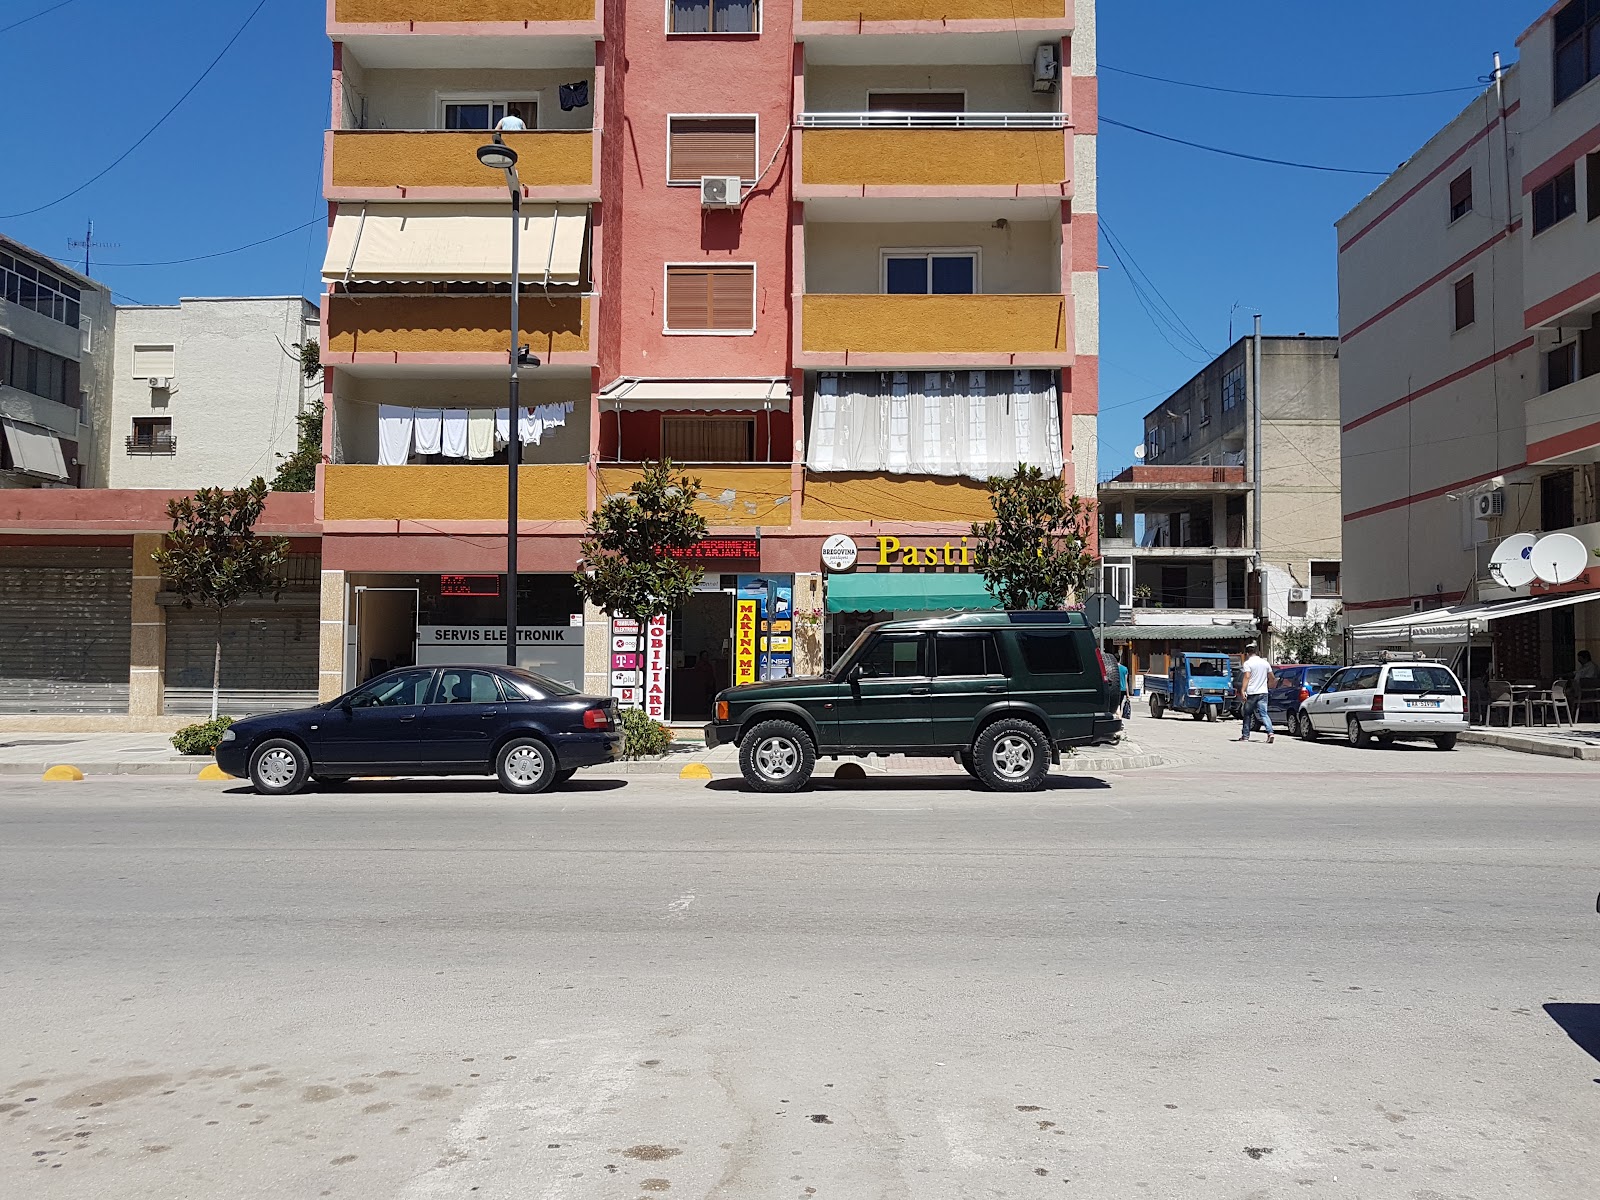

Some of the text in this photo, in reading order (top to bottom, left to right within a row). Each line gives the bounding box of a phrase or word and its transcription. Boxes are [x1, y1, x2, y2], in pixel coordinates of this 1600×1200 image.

[705, 548, 741, 557] ARJANI
[822, 548, 855, 556] BREGOVINA
[435, 629, 565, 641] SERVIS ELETRONIK
[739, 605, 753, 655] MAKINA
[739, 659, 752, 676] ME
[622, 674, 637, 684] plu
